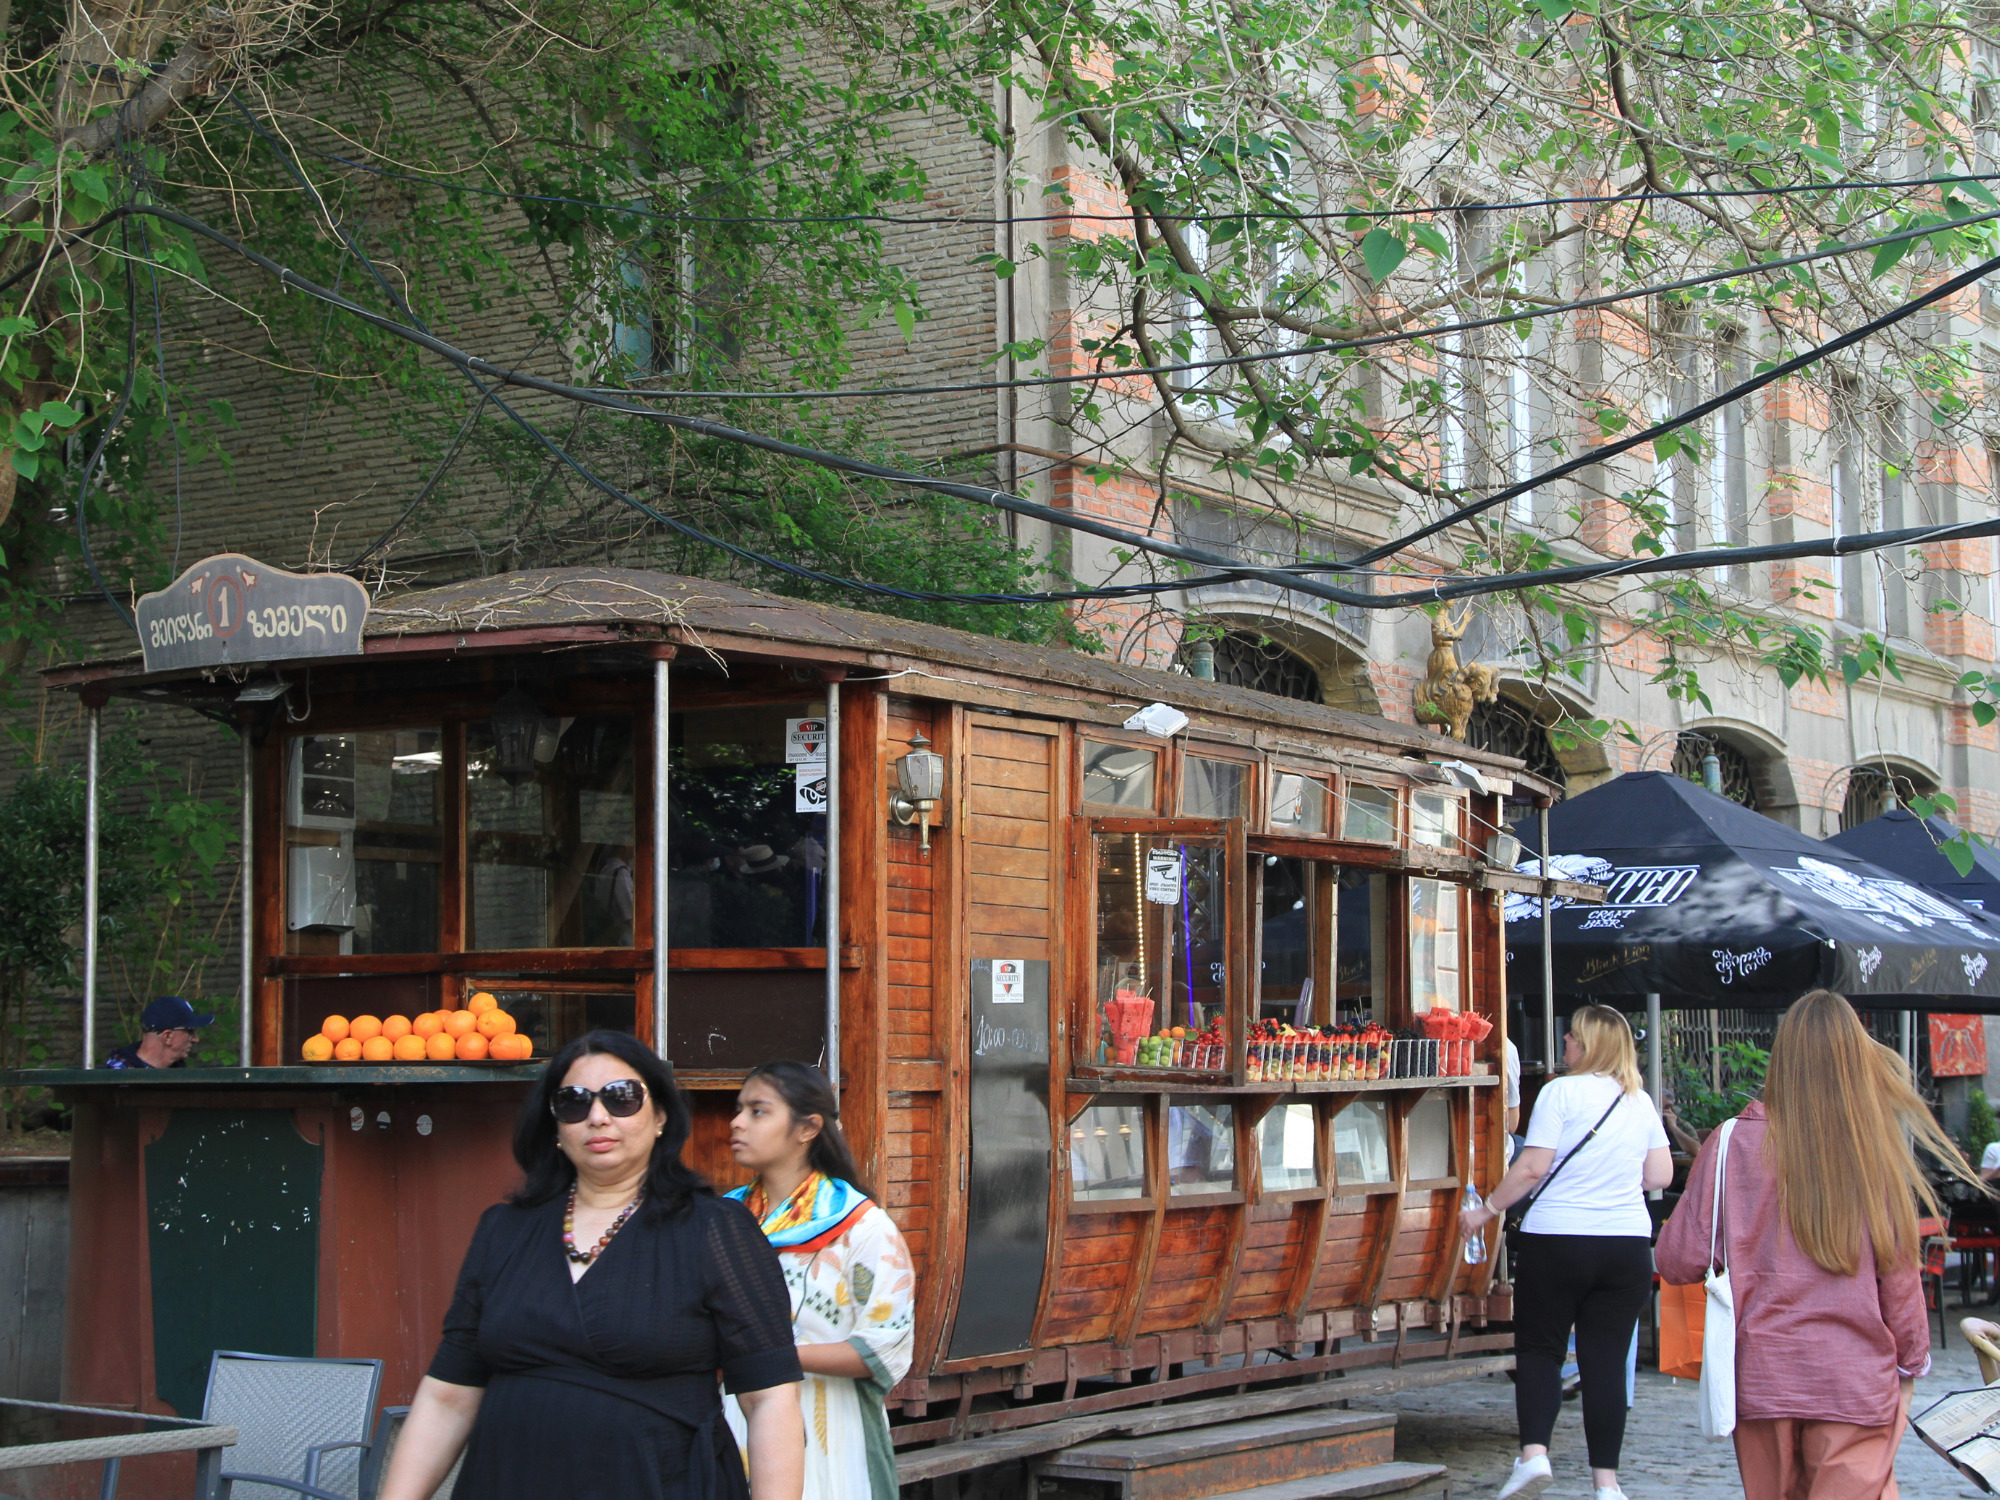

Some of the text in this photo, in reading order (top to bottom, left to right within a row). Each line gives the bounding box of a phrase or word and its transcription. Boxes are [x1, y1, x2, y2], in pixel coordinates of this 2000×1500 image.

[218, 586, 230, 627] 1
[247, 604, 347, 638] ზემელი
[793, 733, 825, 741] SECURIT
[1588, 910, 1635, 919] CRAFT
[1578, 919, 1624, 929] BEER
